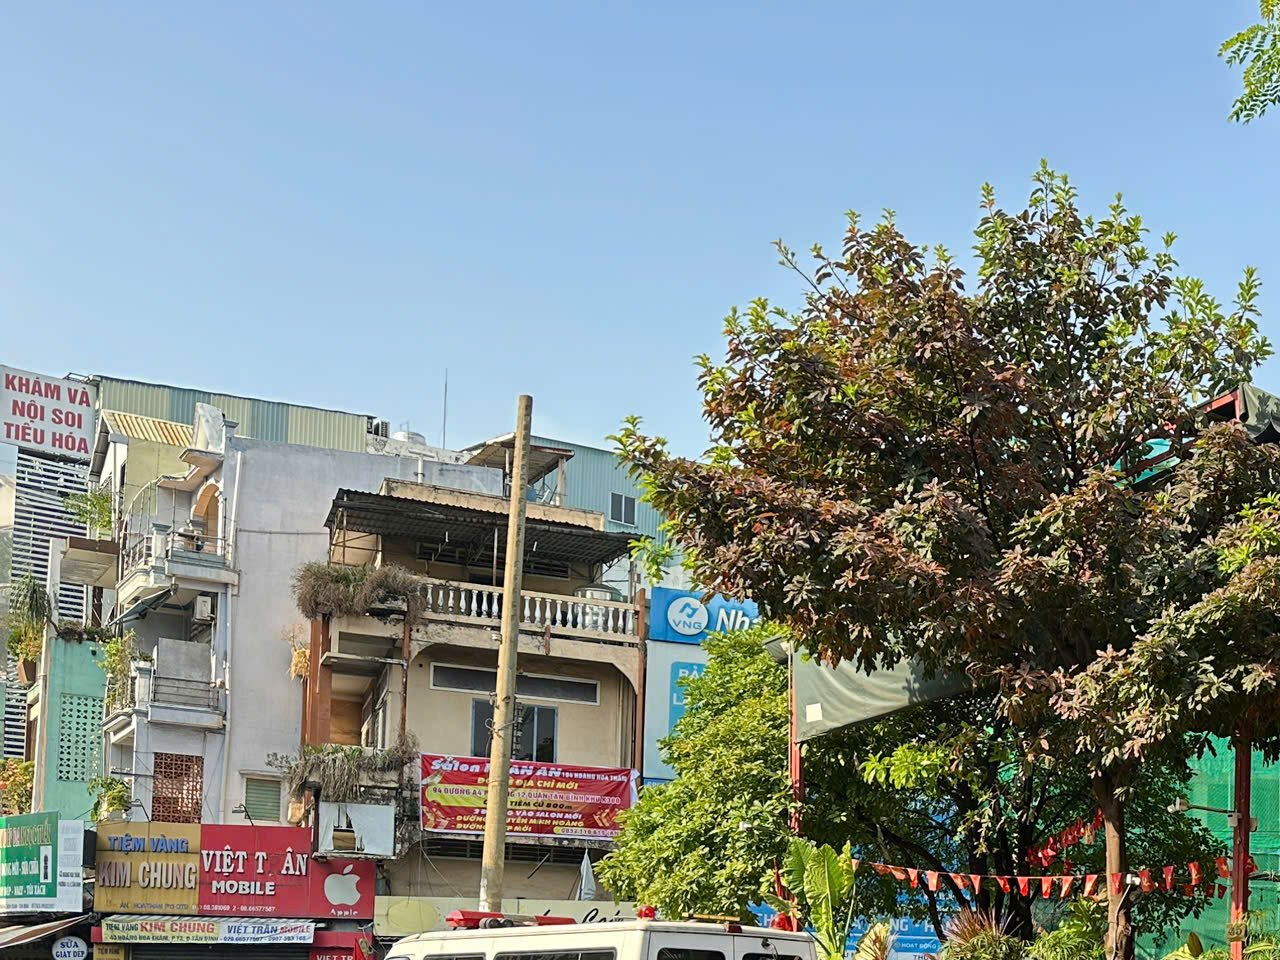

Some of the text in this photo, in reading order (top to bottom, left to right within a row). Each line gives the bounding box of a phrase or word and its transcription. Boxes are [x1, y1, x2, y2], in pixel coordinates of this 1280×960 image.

[5, 373, 91, 407] KHÁM VÀ
[12, 400, 82, 429] NỘI SOI
[4, 421, 89, 454] TIÊU HÓA
[672, 619, 702, 630] VNG
[107, 832, 145, 855] TIỆM
[149, 833, 189, 853] VÀNG
[201, 844, 247, 876] VIỆT
[99, 861, 198, 889] KIM CHUNG
[211, 879, 277, 895] MOBILE
[330, 908, 358, 917] Apple
[140, 921, 166, 933] KIM
[170, 922, 215, 934] CHUNG
[227, 922, 248, 935] VIỆT
